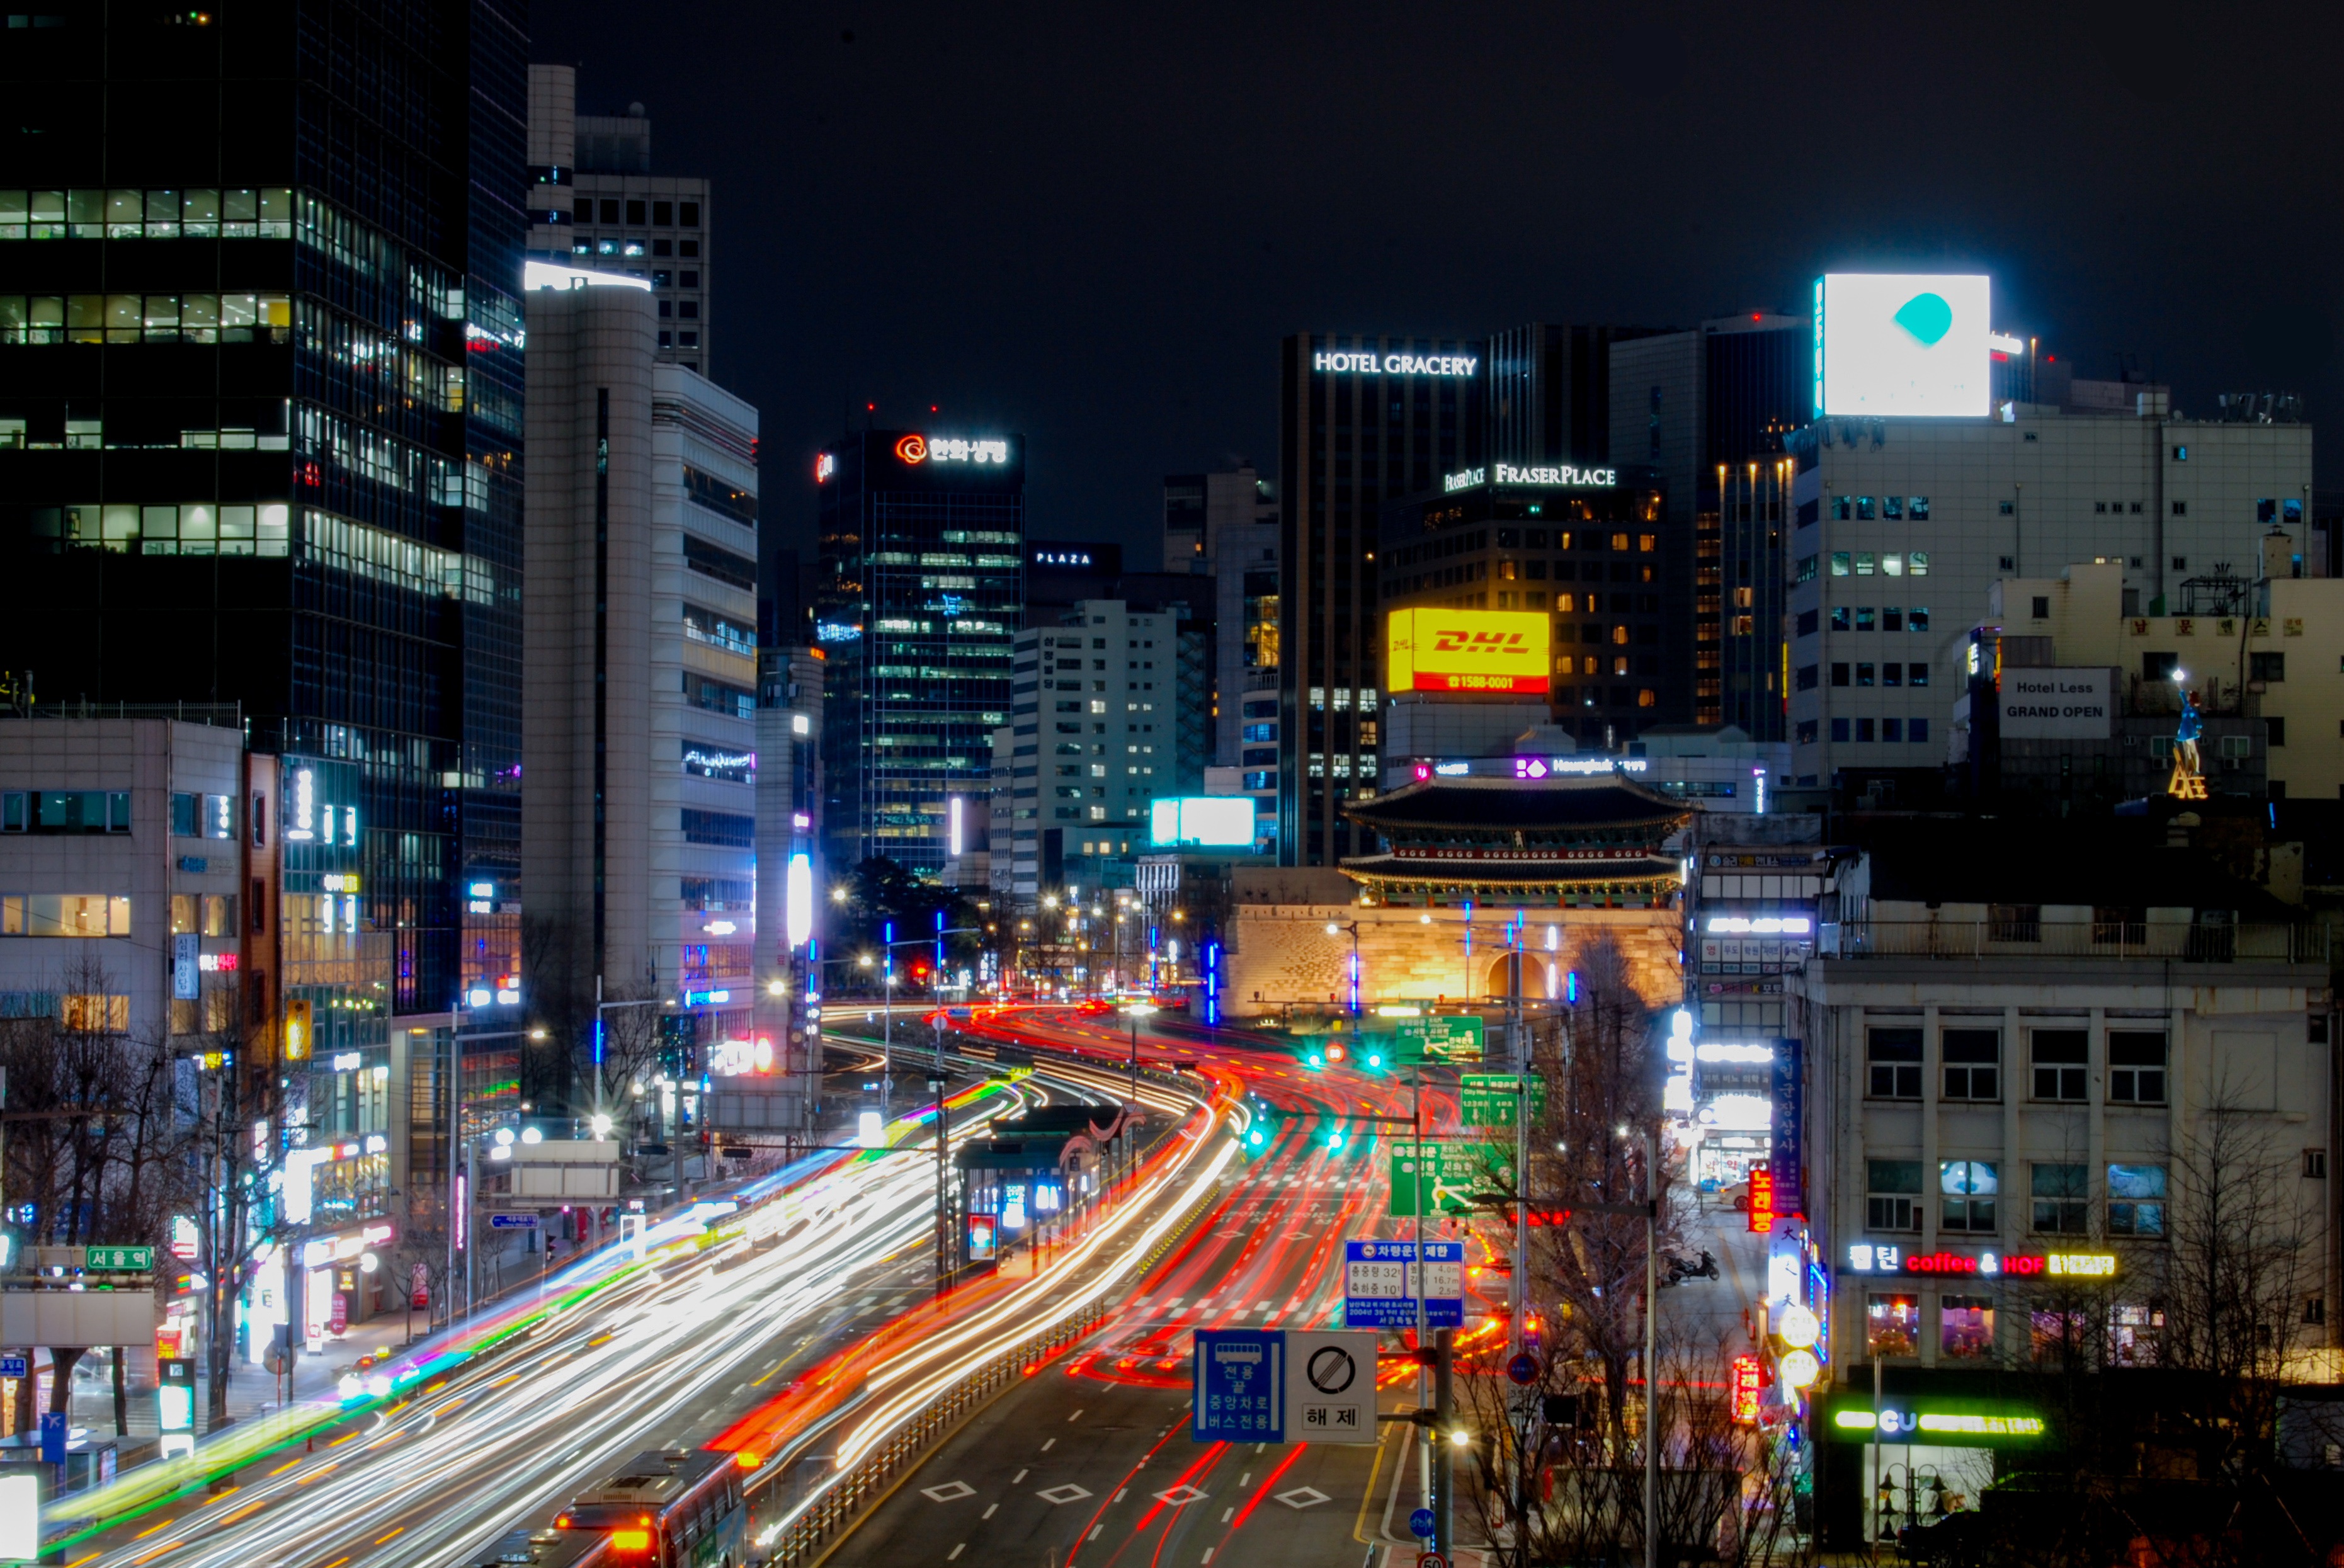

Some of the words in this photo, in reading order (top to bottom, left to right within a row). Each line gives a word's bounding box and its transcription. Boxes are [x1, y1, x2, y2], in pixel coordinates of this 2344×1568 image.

[1316, 353, 1382, 372] HOTEL
[1385, 355, 1477, 375] GRACERY
[929, 439, 1006, 463] 한화생명
[1037, 553, 1090, 564] PLAZA
[1433, 630, 1530, 654] DHL
[1461, 676, 1513, 688] 1588-0001
[2017, 683, 2054, 693] Hotel
[2060, 683, 2093, 693] Less
[2007, 707, 2059, 717] GRAND
[2062, 707, 2103, 717] OPEN
[1553, 758, 1613, 774] Heungkuk
[178, 938, 188, 991] 심리상담
[1753, 1171, 1773, 1232] 노래방
[93, 1251, 147, 1266] 서울역
[1378, 1245, 1448, 1258] 차량운제한
[1906, 1253, 1977, 1273] coffee
[1980, 1253, 1997, 1273] &
[2003, 1256, 2045, 1274] HOF
[1351, 1266, 1379, 1278] 총중량
[1434, 1276, 1459, 1285] 16.7m
[1351, 1283, 1379, 1295] 축하중
[1439, 1287, 1459, 1295] 2.5m
[1224, 1366, 1254, 1380] 전용
[1232, 1381, 1244, 1394] 끝
[1209, 1395, 1268, 1410] 중앙차로
[1209, 1414, 1268, 1429] 버스전용
[1307, 1408, 1356, 1426] 해제
[1879, 1410, 1917, 1432] CU
